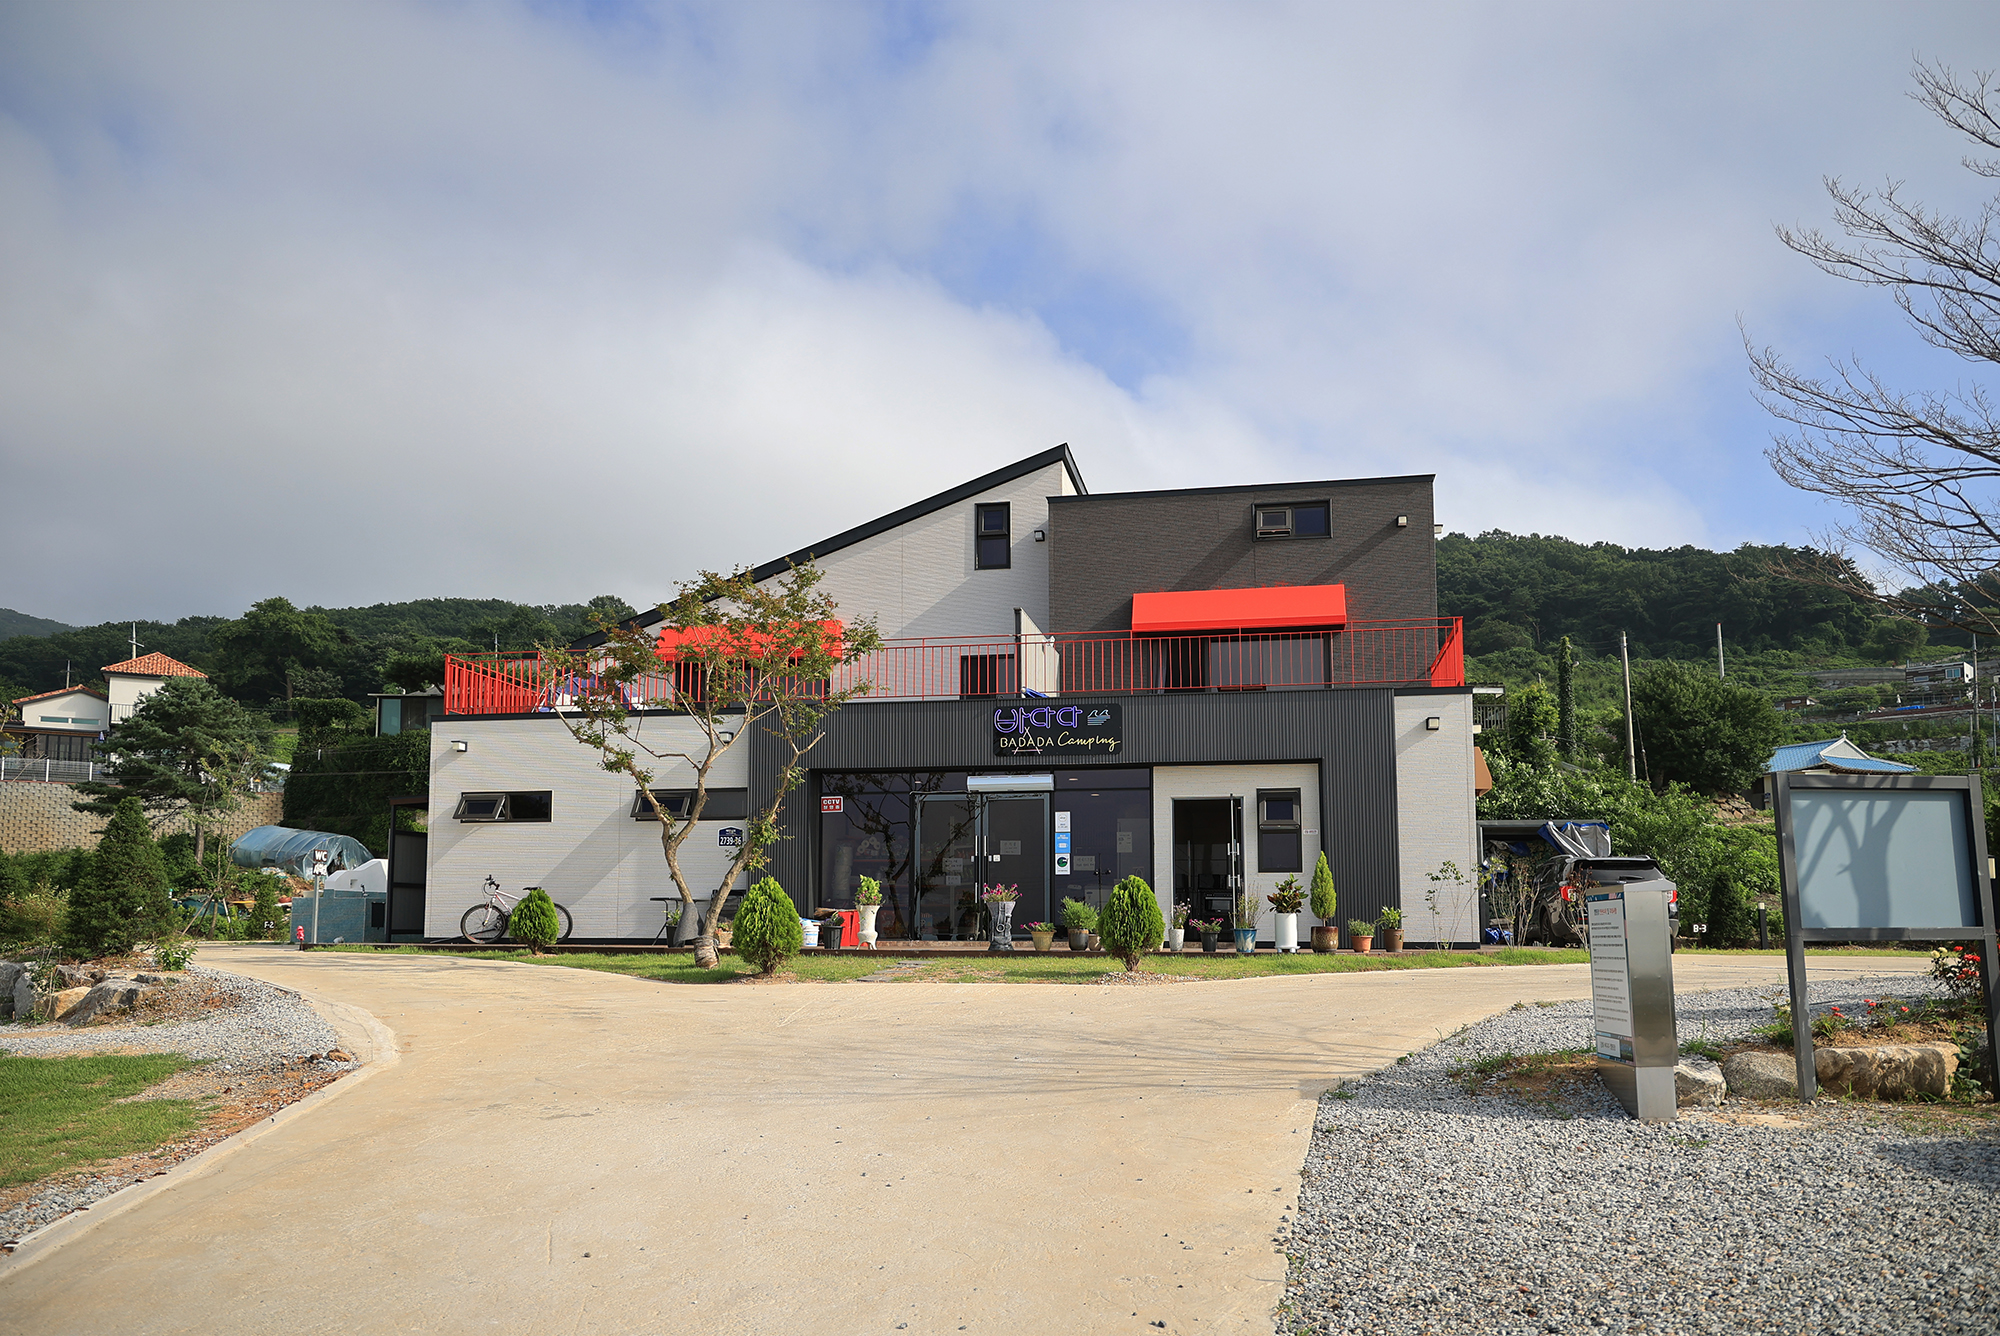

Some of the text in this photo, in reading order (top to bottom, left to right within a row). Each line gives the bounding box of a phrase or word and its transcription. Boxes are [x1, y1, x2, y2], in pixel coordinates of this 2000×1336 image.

[994, 705, 1083, 734] 바다다
[1000, 731, 1121, 752] BADADA Camping
[315, 850, 328, 861] WC
[264, 921, 275, 929] F-2
[1692, 924, 1707, 933] B-3
